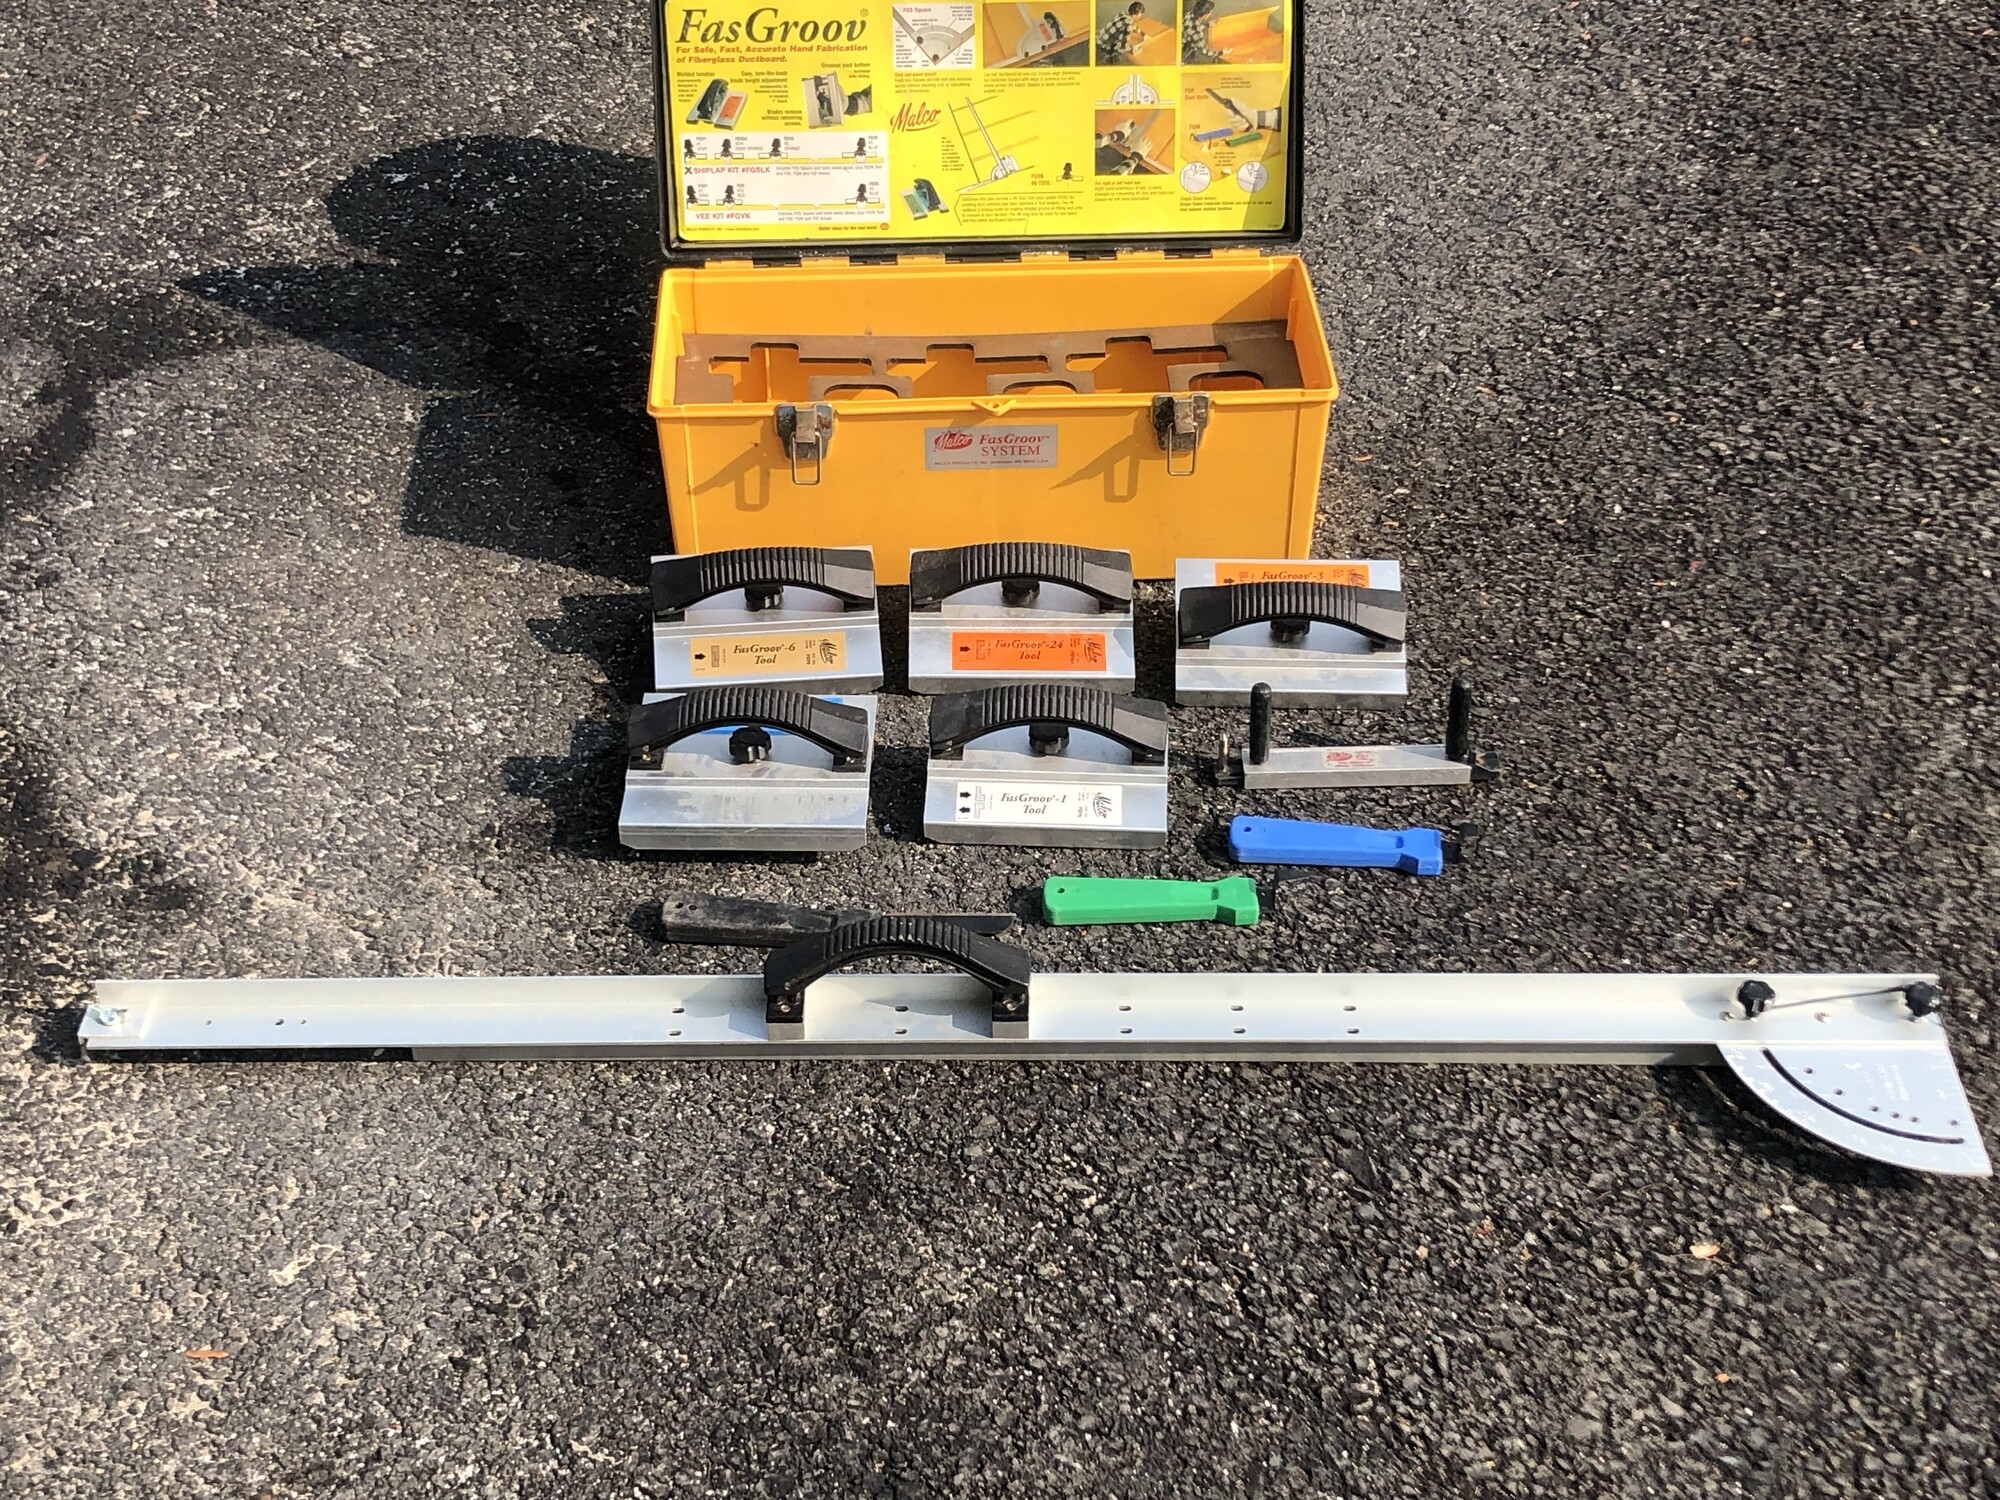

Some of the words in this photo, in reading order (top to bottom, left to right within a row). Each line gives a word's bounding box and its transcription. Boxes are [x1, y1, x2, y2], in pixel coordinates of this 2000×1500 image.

[694, 46, 716, 54] Safe,
[720, 46, 742, 54] Fast,
[745, 45, 786, 53] Accurate
[816, 44, 868, 52] Fabrication
[688, 56, 735, 65] Fiberglass
[738, 55, 787, 63] Ductboard.
[981, 445, 1041, 457] SYSTEM
[754, 654, 777, 665] Tool
[1019, 650, 1041, 660] Tool
[1023, 804, 1047, 815] Tool
